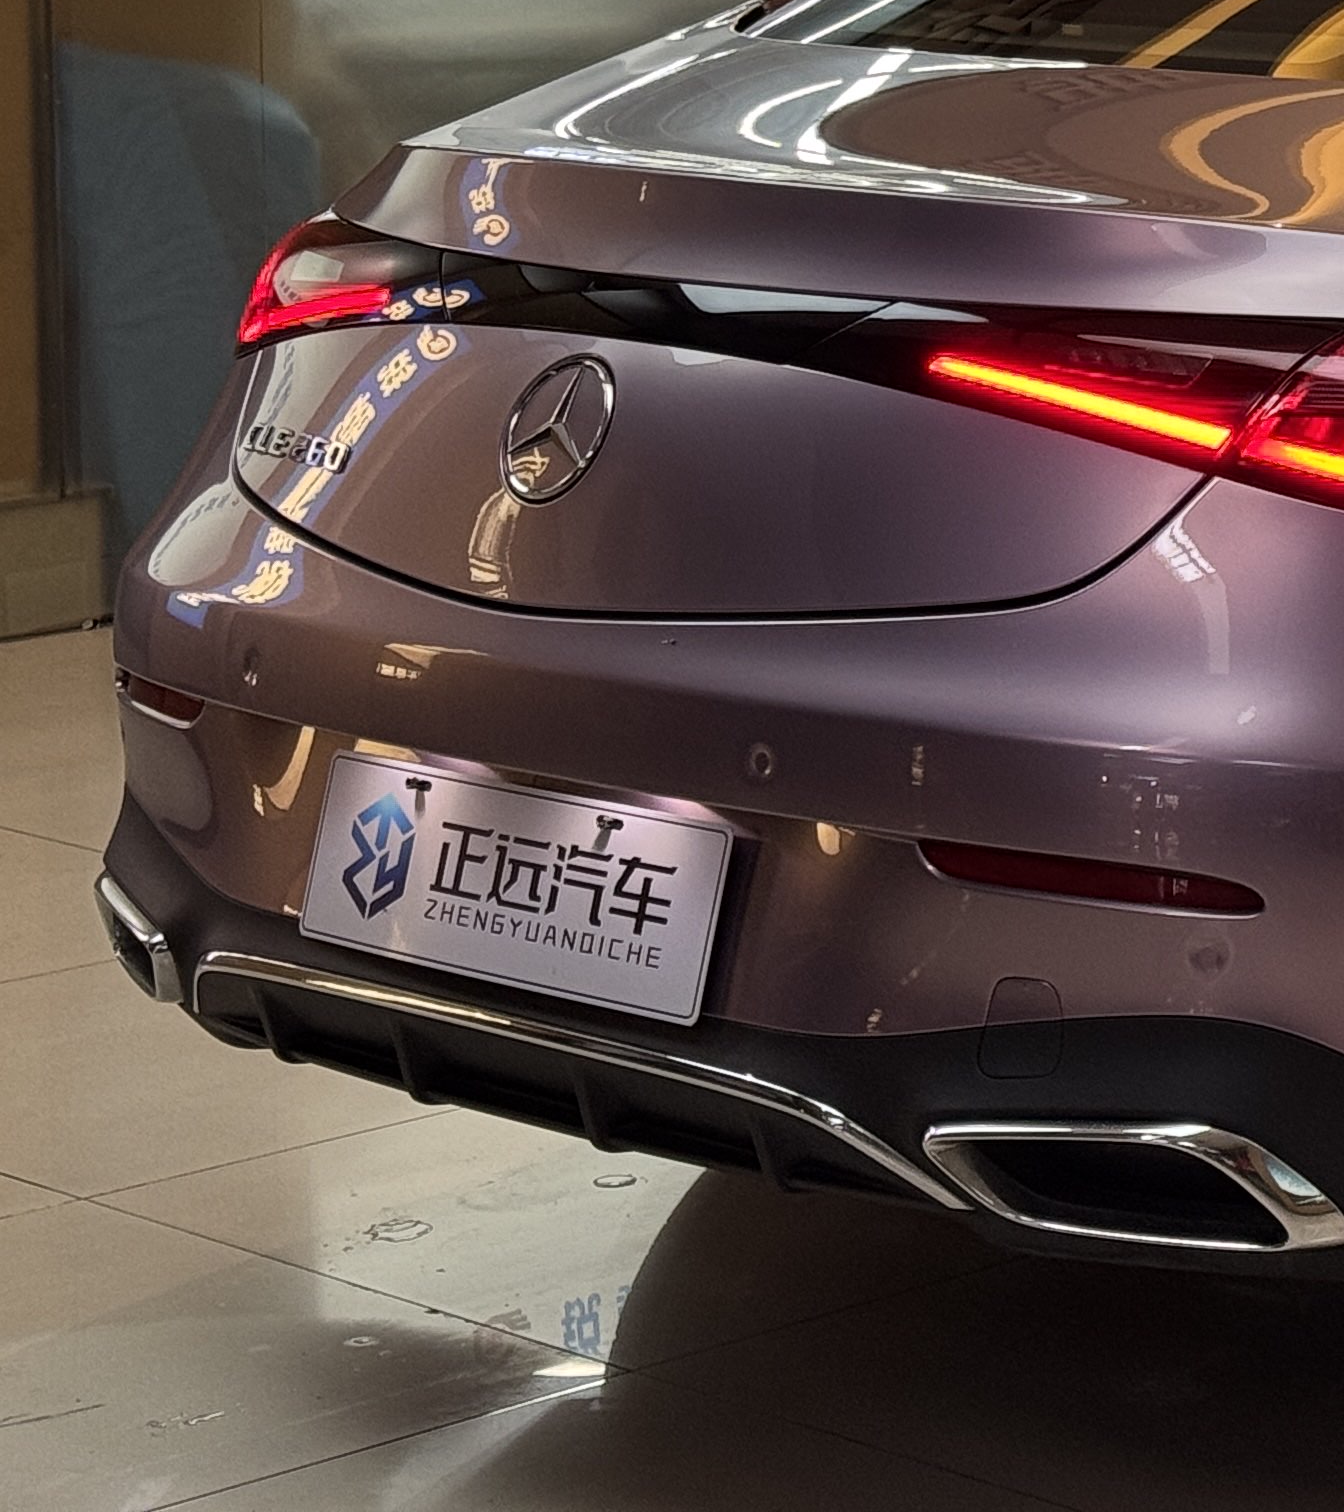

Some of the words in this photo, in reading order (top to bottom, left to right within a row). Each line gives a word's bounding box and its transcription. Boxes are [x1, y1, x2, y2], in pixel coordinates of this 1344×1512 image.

[428, 821, 679, 937] 正远汽车
[423, 898, 664, 971] ZHENGYUANQICHE
